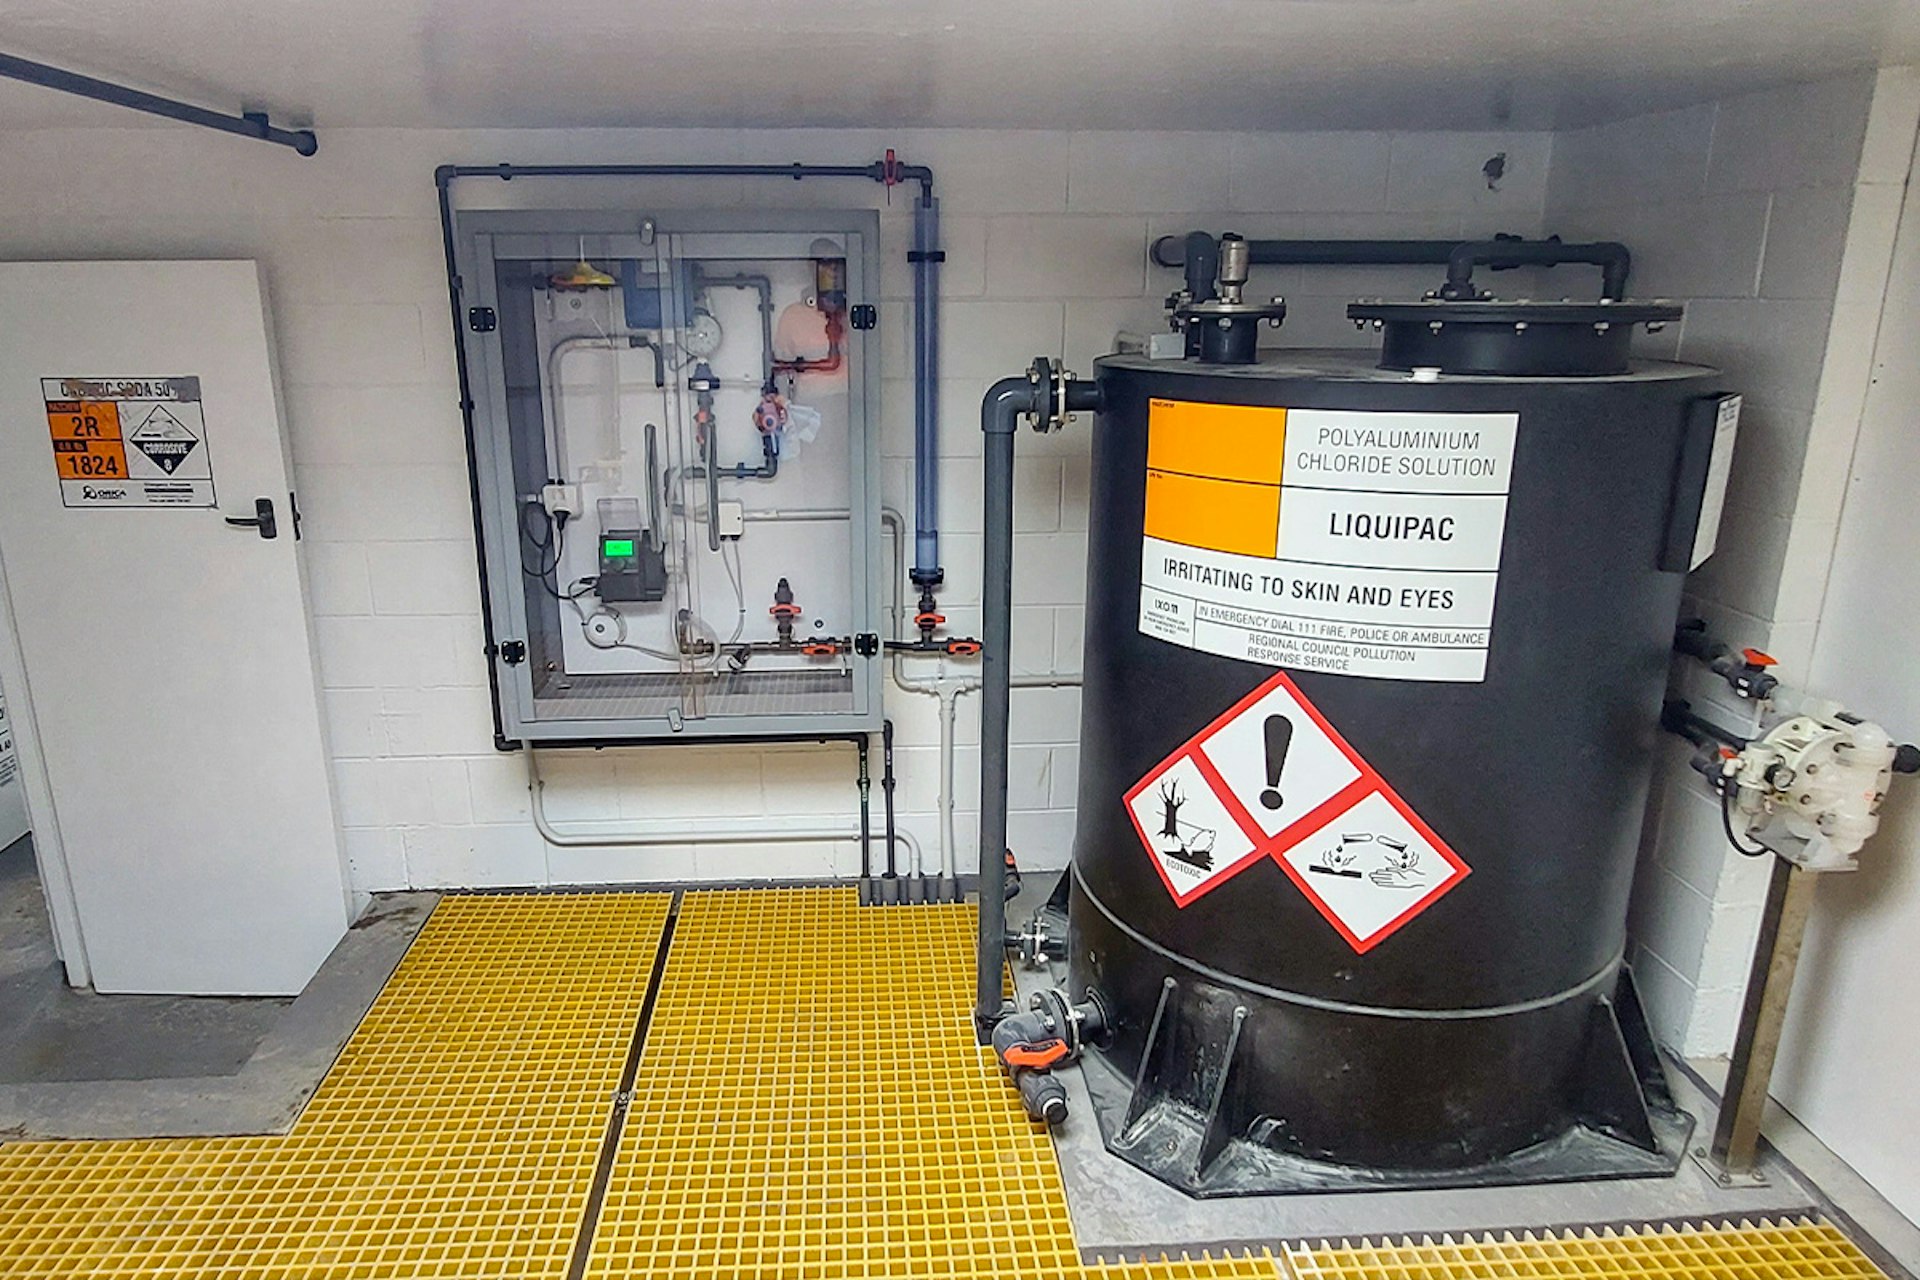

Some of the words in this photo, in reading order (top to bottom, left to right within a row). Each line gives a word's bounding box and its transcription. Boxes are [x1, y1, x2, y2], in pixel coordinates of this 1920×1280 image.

[72, 416, 100, 437] 2R
[143, 442, 189, 454] CORROSIVE
[1318, 428, 1479, 450] POLYALUMINIUM
[68, 455, 118, 475] 1824
[163, 458, 173, 471] 8
[1298, 452, 1393, 474] CHLORIDE
[1398, 456, 1496, 476] SOLUTION
[1329, 512, 1454, 541] LIQUIPAC
[1163, 558, 1252, 591] IRRITATING
[1260, 576, 1284, 595] TO
[1292, 581, 1341, 602] SKIN
[1347, 587, 1391, 606] AND
[1400, 590, 1454, 609] EYES
[1198, 606, 1208, 618] IN
[1211, 608, 1268, 628] EMERGENCY
[1271, 618, 1294, 631] DIAL
[1299, 621, 1316, 634] 111
[1320, 624, 1346, 638] FIRE,
[1350, 627, 1389, 641] POLICE
[1392, 629, 1408, 642] OR
[1411, 631, 1484, 644] AMBULANCE
[1248, 647, 1300, 665] RESPONSE
[1303, 654, 1349, 671] SERVICE
[1249, 633, 1298, 649] REGIONAL
[1302, 641, 1349, 656] COUNCIL
[1353, 647, 1416, 661] POLLUTION
